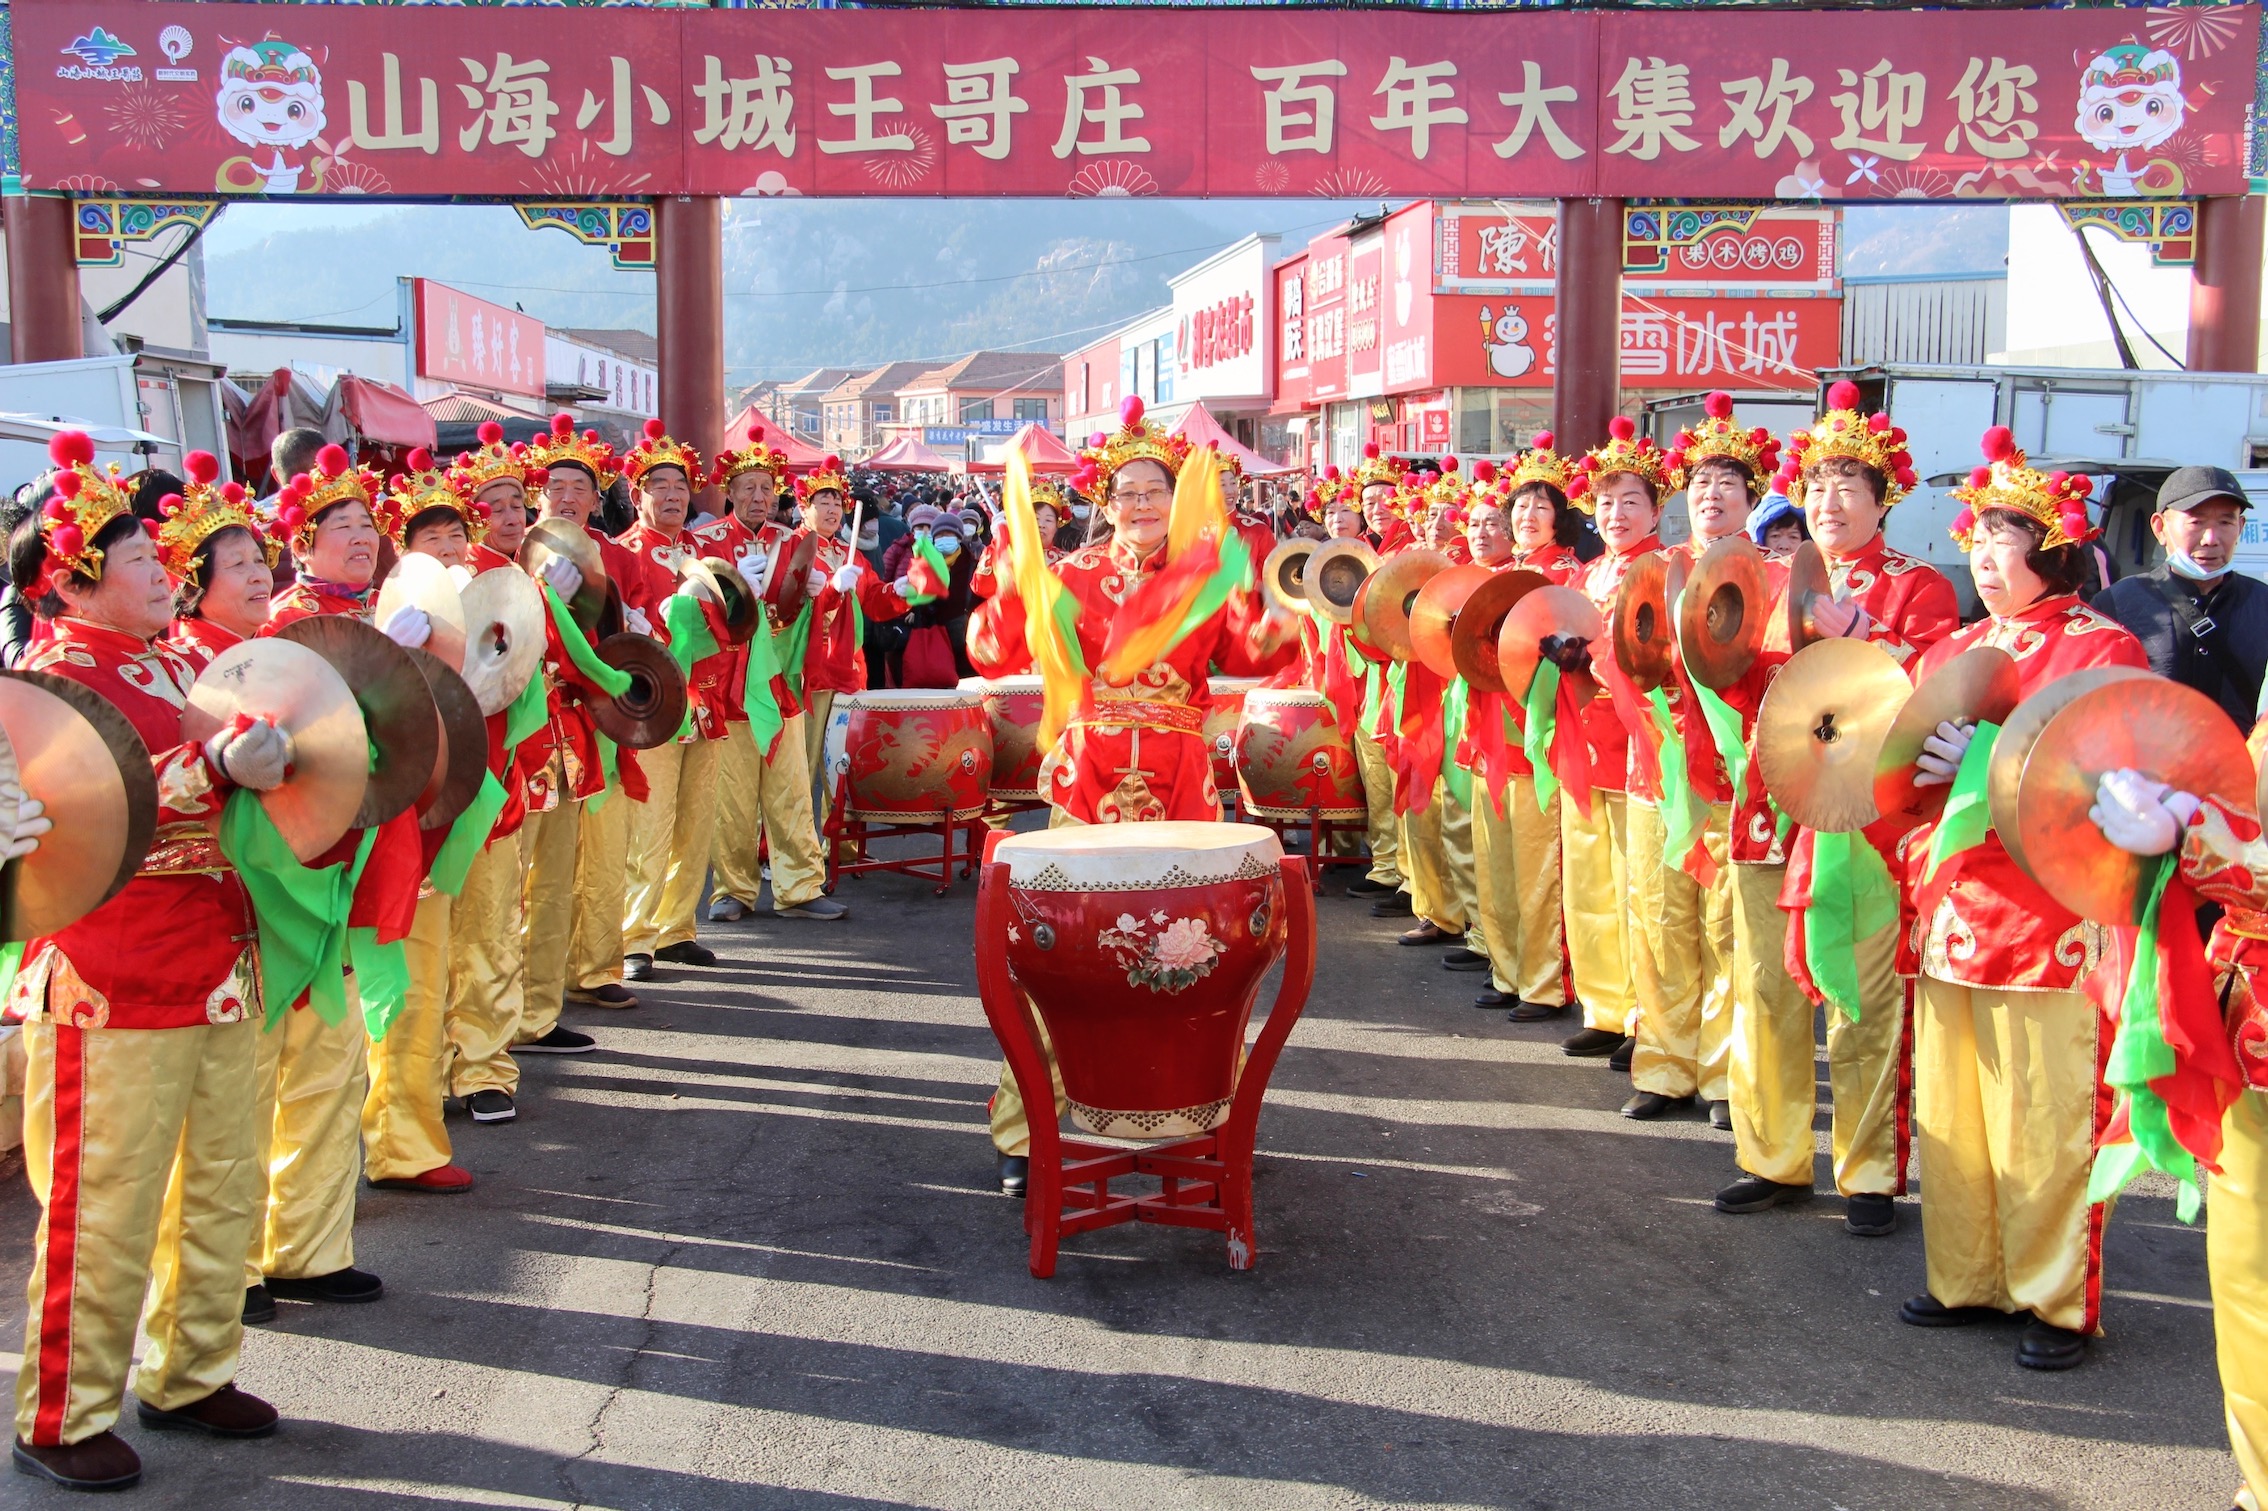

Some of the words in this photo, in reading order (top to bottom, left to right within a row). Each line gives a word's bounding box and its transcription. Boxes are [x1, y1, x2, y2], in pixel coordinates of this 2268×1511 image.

[346, 52, 1153, 160] 山海小城王哥庄
[1250, 55, 2040, 162] 百年大集欢迎您
[1685, 242, 1799, 264] 果木烤鸡
[1542, 310, 1797, 376] 雪冰城
